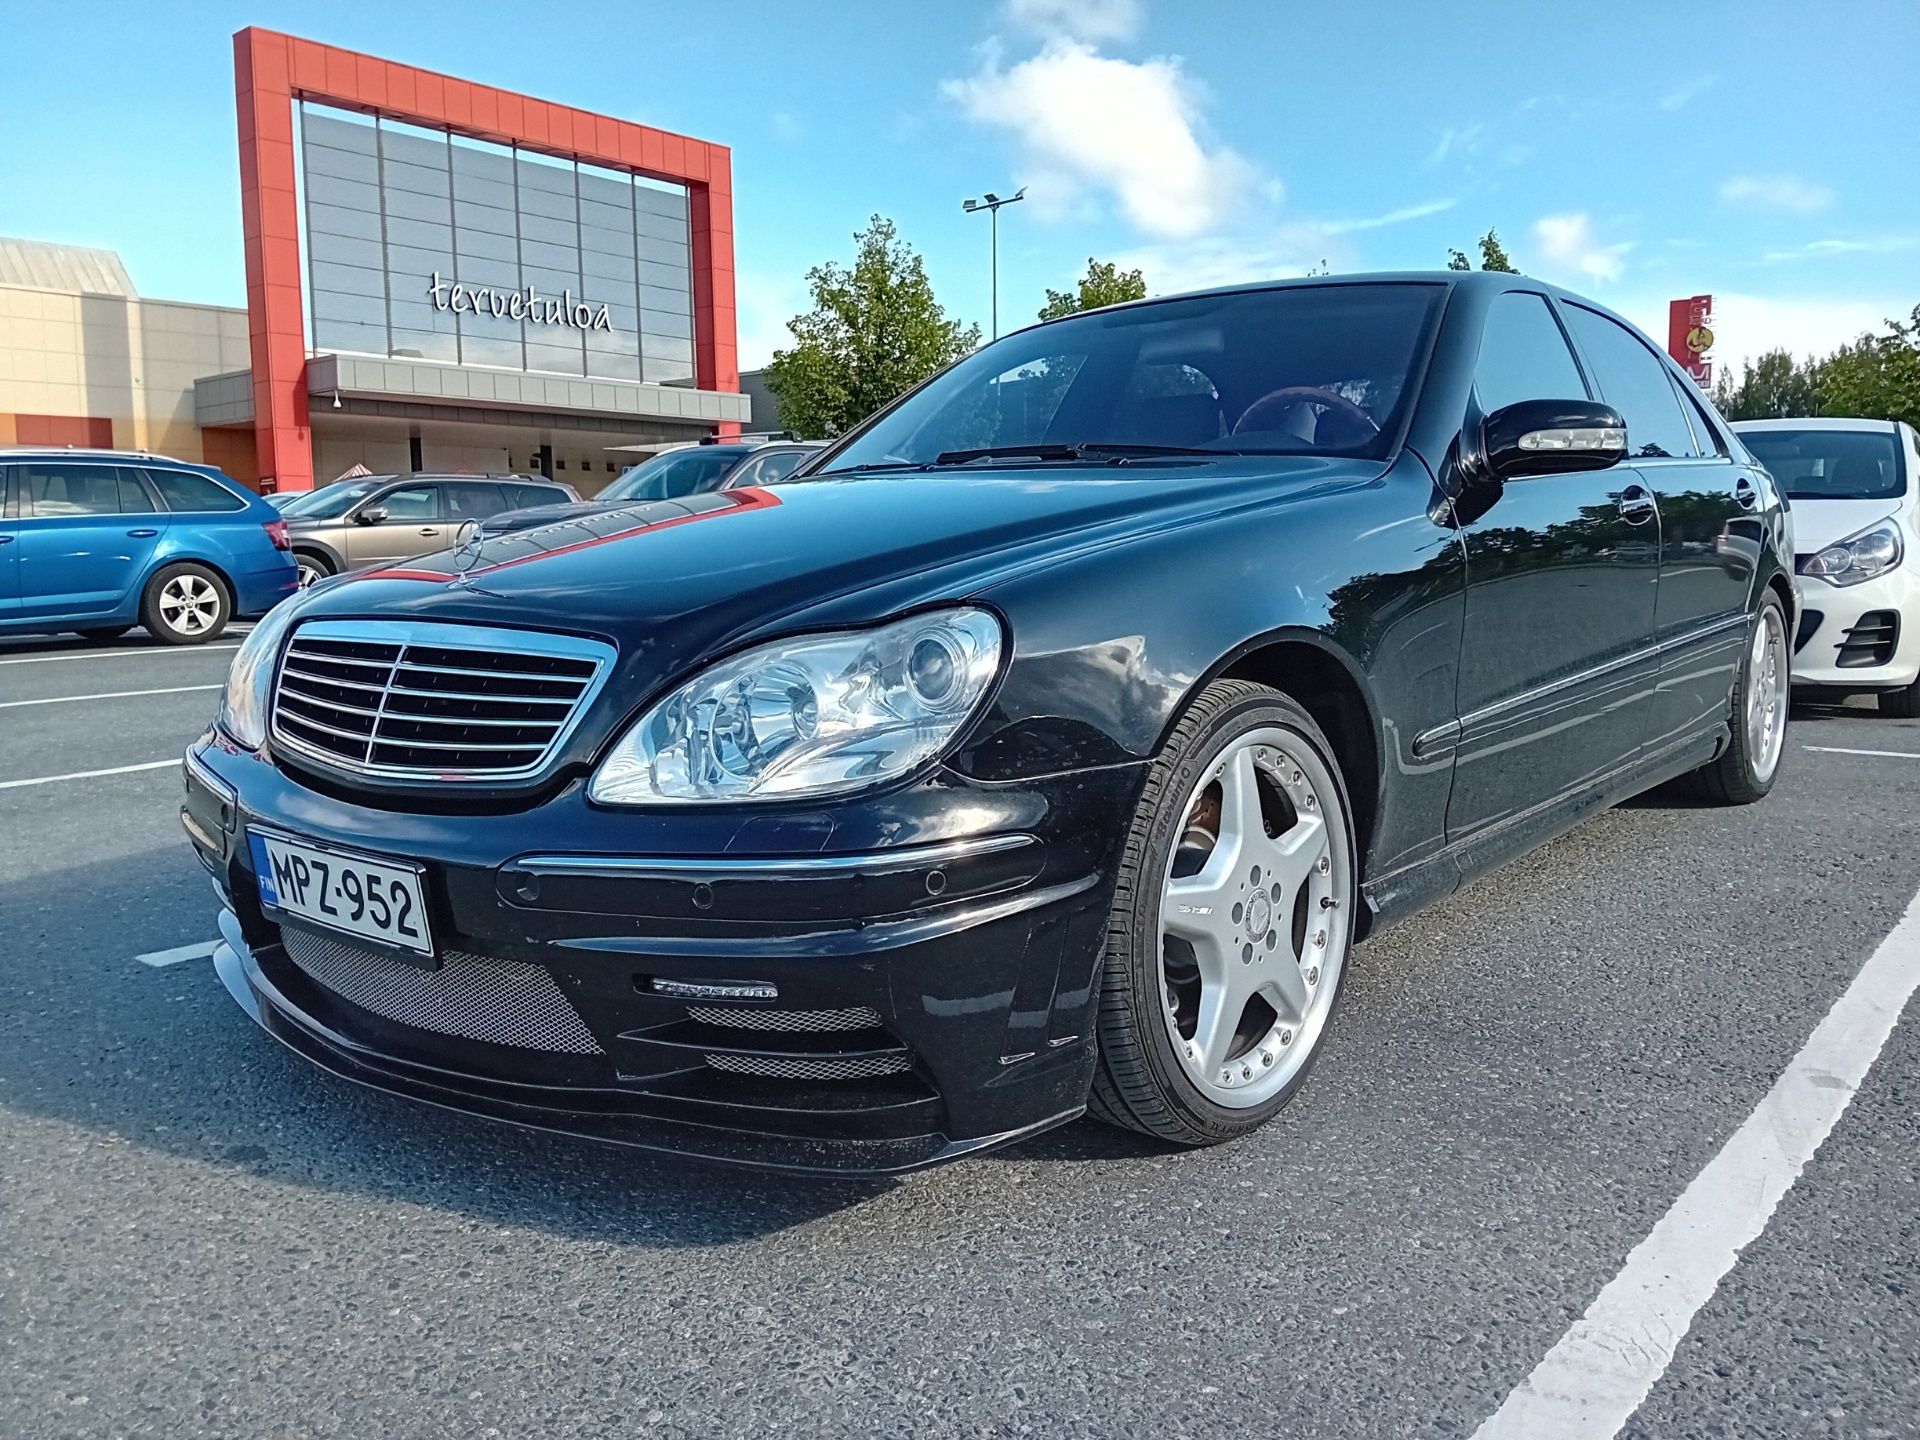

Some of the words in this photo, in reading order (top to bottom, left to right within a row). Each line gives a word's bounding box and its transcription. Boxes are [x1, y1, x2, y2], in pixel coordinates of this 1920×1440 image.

[429, 271, 614, 333] tervetuloa
[259, 874, 276, 893] FIN
[270, 848, 420, 939] MPZ-952
